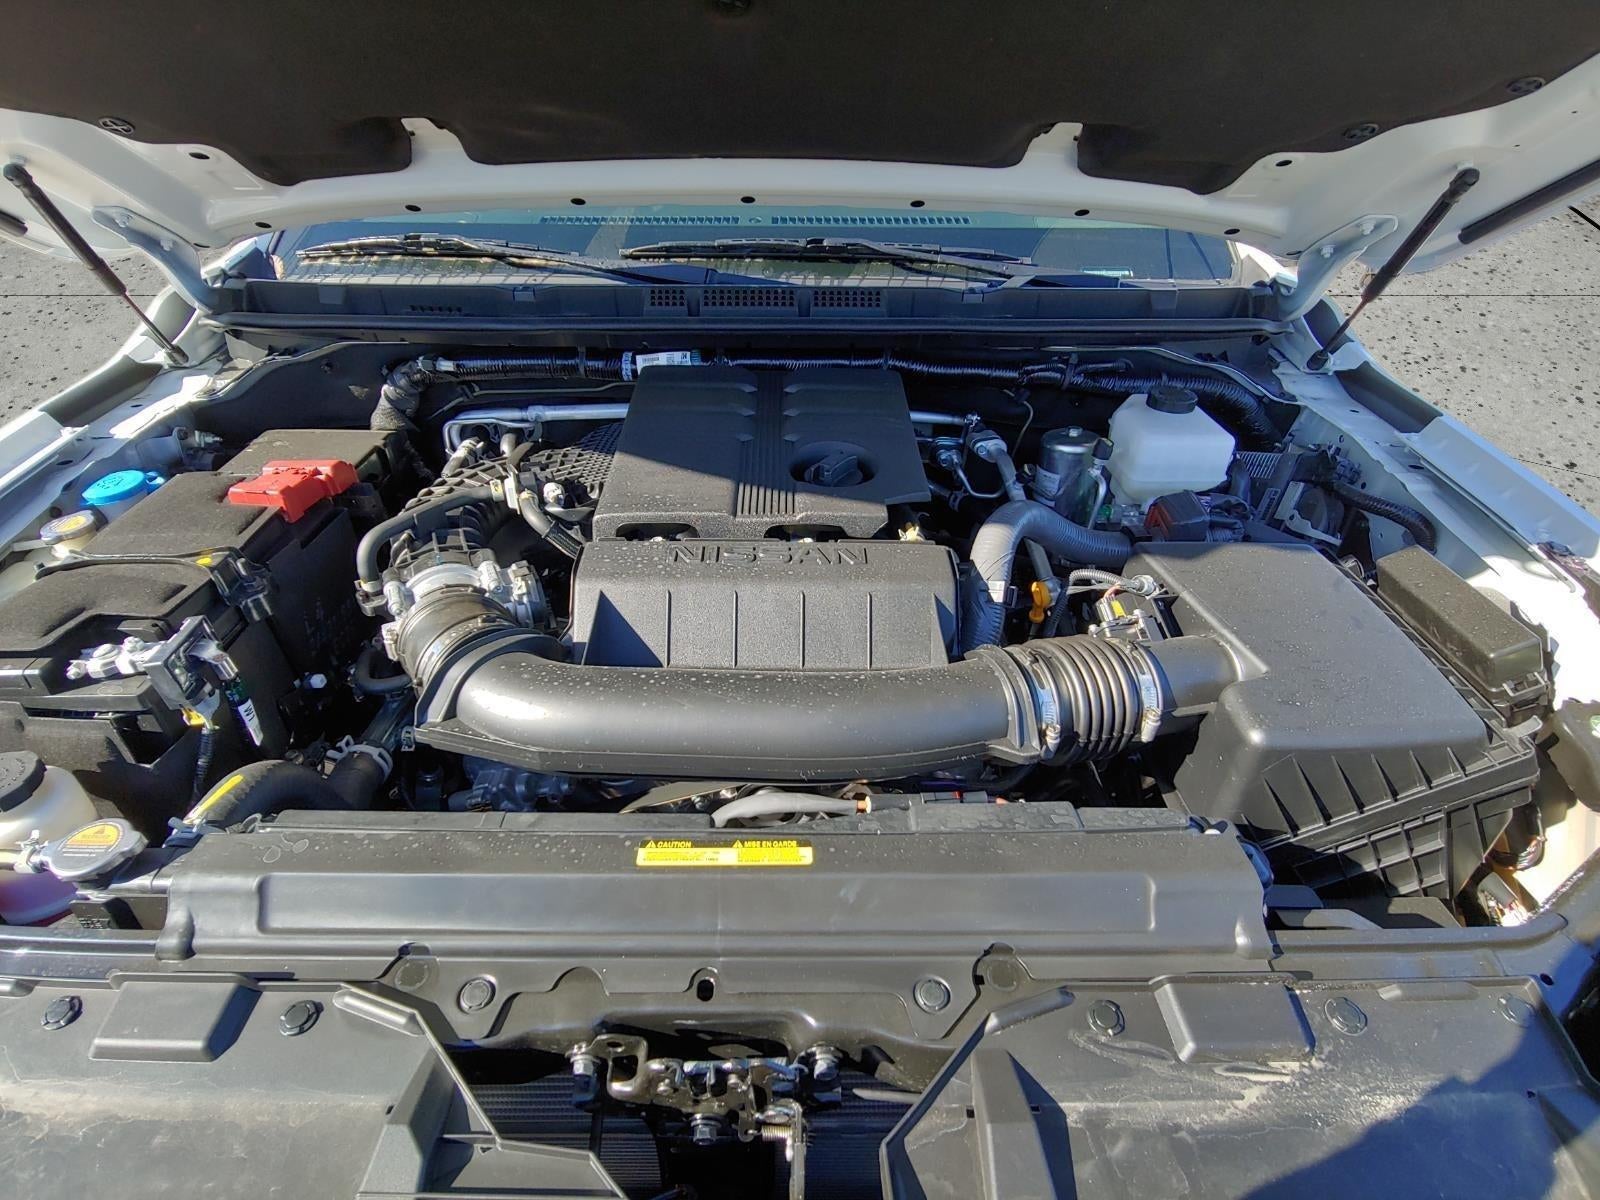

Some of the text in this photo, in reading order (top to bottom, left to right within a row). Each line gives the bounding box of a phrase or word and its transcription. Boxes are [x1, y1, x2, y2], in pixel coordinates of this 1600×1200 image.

[671, 545, 869, 565] NISSAN
[657, 840, 692, 849] CAUTION
[744, 840, 797, 849] MISE EN GARDE
